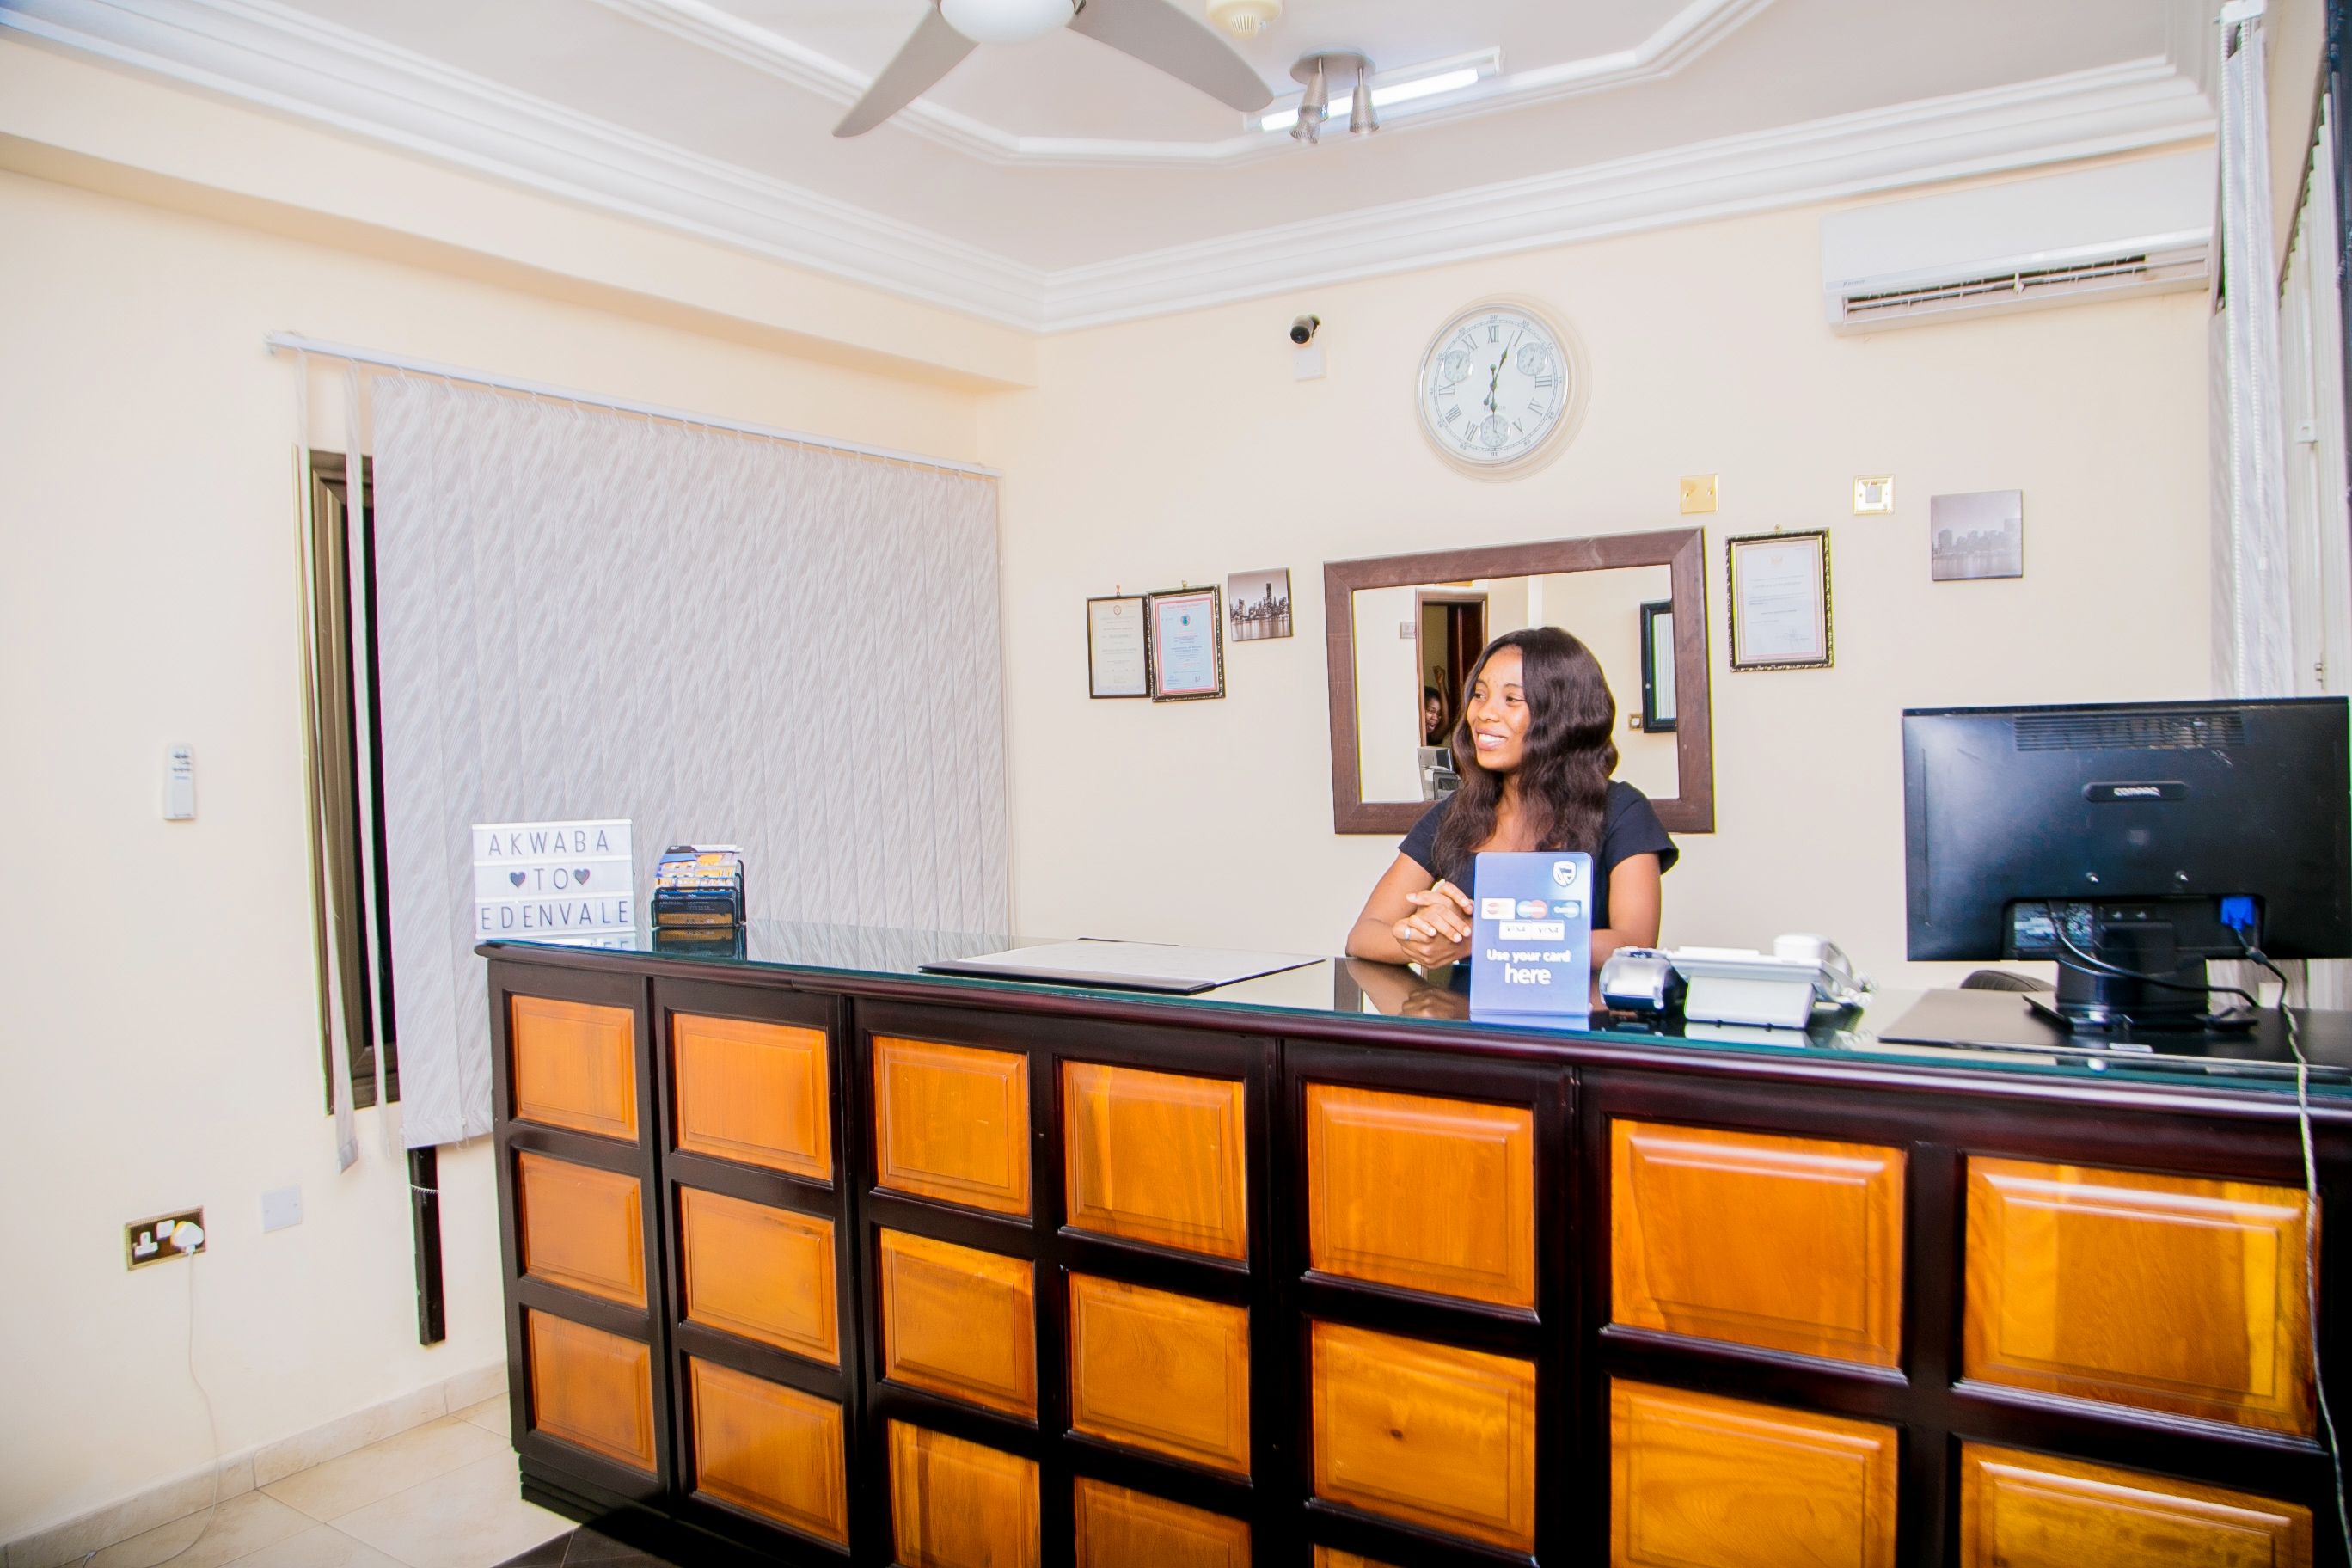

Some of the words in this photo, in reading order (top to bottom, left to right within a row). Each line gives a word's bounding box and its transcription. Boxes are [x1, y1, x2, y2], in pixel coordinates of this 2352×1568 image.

[488, 829, 610, 856] AKWABA
[533, 867, 569, 891] TO
[481, 900, 629, 931] EDENVALE
[1486, 948, 1510, 962] Use
[1511, 951, 1542, 964] your
[1542, 949, 1571, 963] card
[1504, 962, 1552, 985] here
